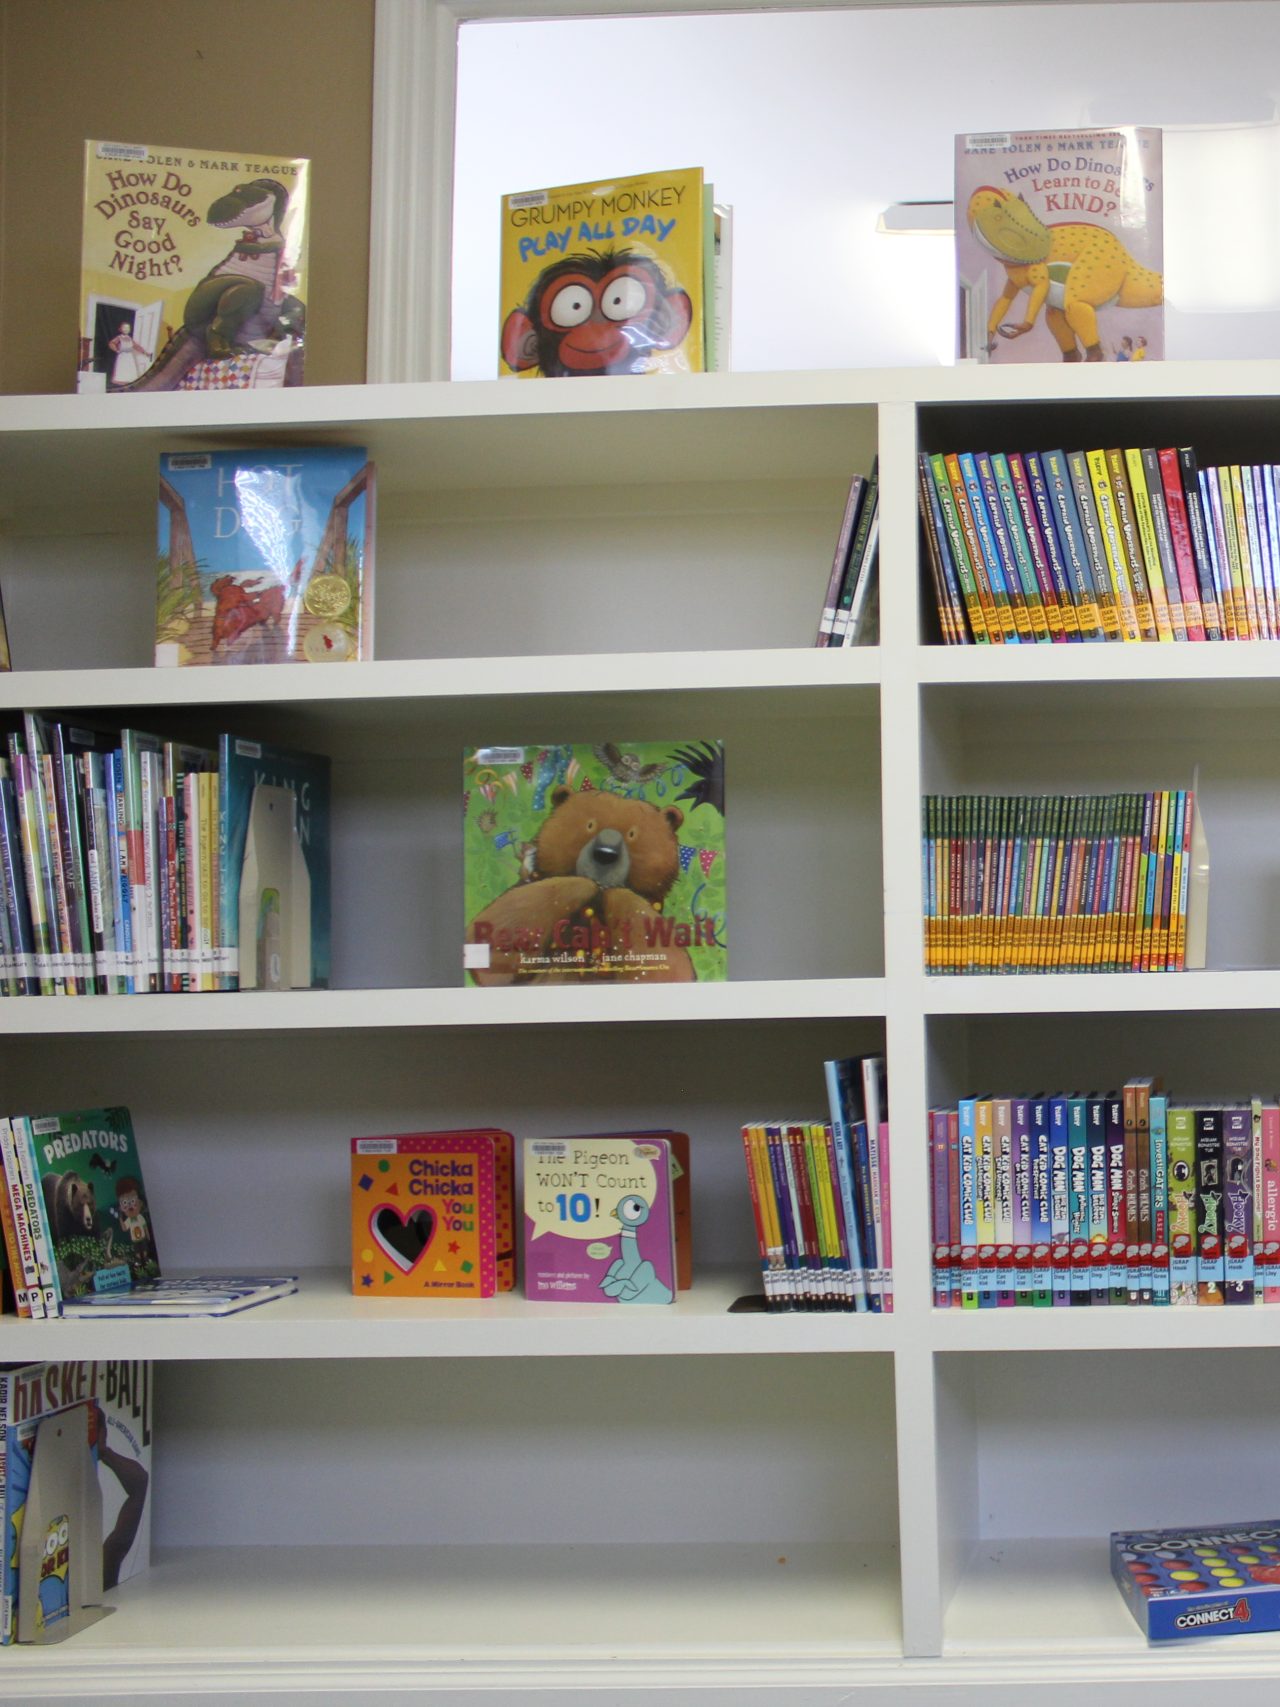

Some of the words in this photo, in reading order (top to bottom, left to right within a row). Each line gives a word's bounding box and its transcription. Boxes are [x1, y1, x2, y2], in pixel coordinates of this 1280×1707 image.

[1058, 141, 1094, 150] MARK
[200, 160, 239, 171] MARK
[245, 164, 298, 176] TEAGUE
[1004, 163, 1041, 183] How
[1047, 158, 1071, 171] Do
[1076, 157, 1154, 192] Dinoss
[106, 170, 157, 191] How
[161, 172, 192, 197] Do
[1032, 176, 1081, 192] Learn
[1085, 176, 1100, 189] to
[94, 191, 200, 227] Dinosaurs
[510, 199, 596, 228] GRUMPY
[601, 186, 686, 216] MONKEY
[1045, 192, 1117, 217] KIND?
[128, 210, 166, 235] Say
[115, 230, 176, 254] Good
[518, 226, 572, 263] PLAY
[577, 221, 615, 242] ALL
[621, 214, 676, 242] DAY
[108, 251, 184, 280] Night?
[214, 505, 302, 538] DG
[474, 921, 543, 951] Bear
[643, 915, 717, 948] Wait
[520, 953, 549, 963] karma
[552, 952, 585, 963] wilson
[602, 953, 622, 963] jane
[624, 951, 667, 964] chapman
[43, 1129, 128, 1165] PREDATORS
[962, 1135, 972, 1153] CAT
[1110, 1144, 1124, 1168] DOG
[408, 1159, 474, 1177] Chicka
[573, 1150, 630, 1171] Pigeon
[1053, 1146, 1066, 1170] DOG
[408, 1178, 474, 1197] Chicka
[536, 1172, 588, 1189] WON'T
[595, 1173, 648, 1189] Count
[24, 1183, 42, 1241] PREDATORS
[442, 1199, 474, 1215] You
[538, 1200, 555, 1213] to
[963, 1200, 974, 1225] CLUB
[1264, 1179, 1275, 1231] allergic
[11, 1184, 21, 1212] MEGA
[16, 1214, 32, 1262] MACHINES
[442, 1216, 474, 1233] You
[18, 1293, 28, 1303] M
[31, 1292, 39, 1302] P
[45, 1292, 53, 1302] P
[1208, 1282, 1216, 1293] 2
[1236, 1281, 1244, 1292] 3
[1176, 1609, 1235, 1628] CONNECT
[1233, 1598, 1249, 1622] 4
